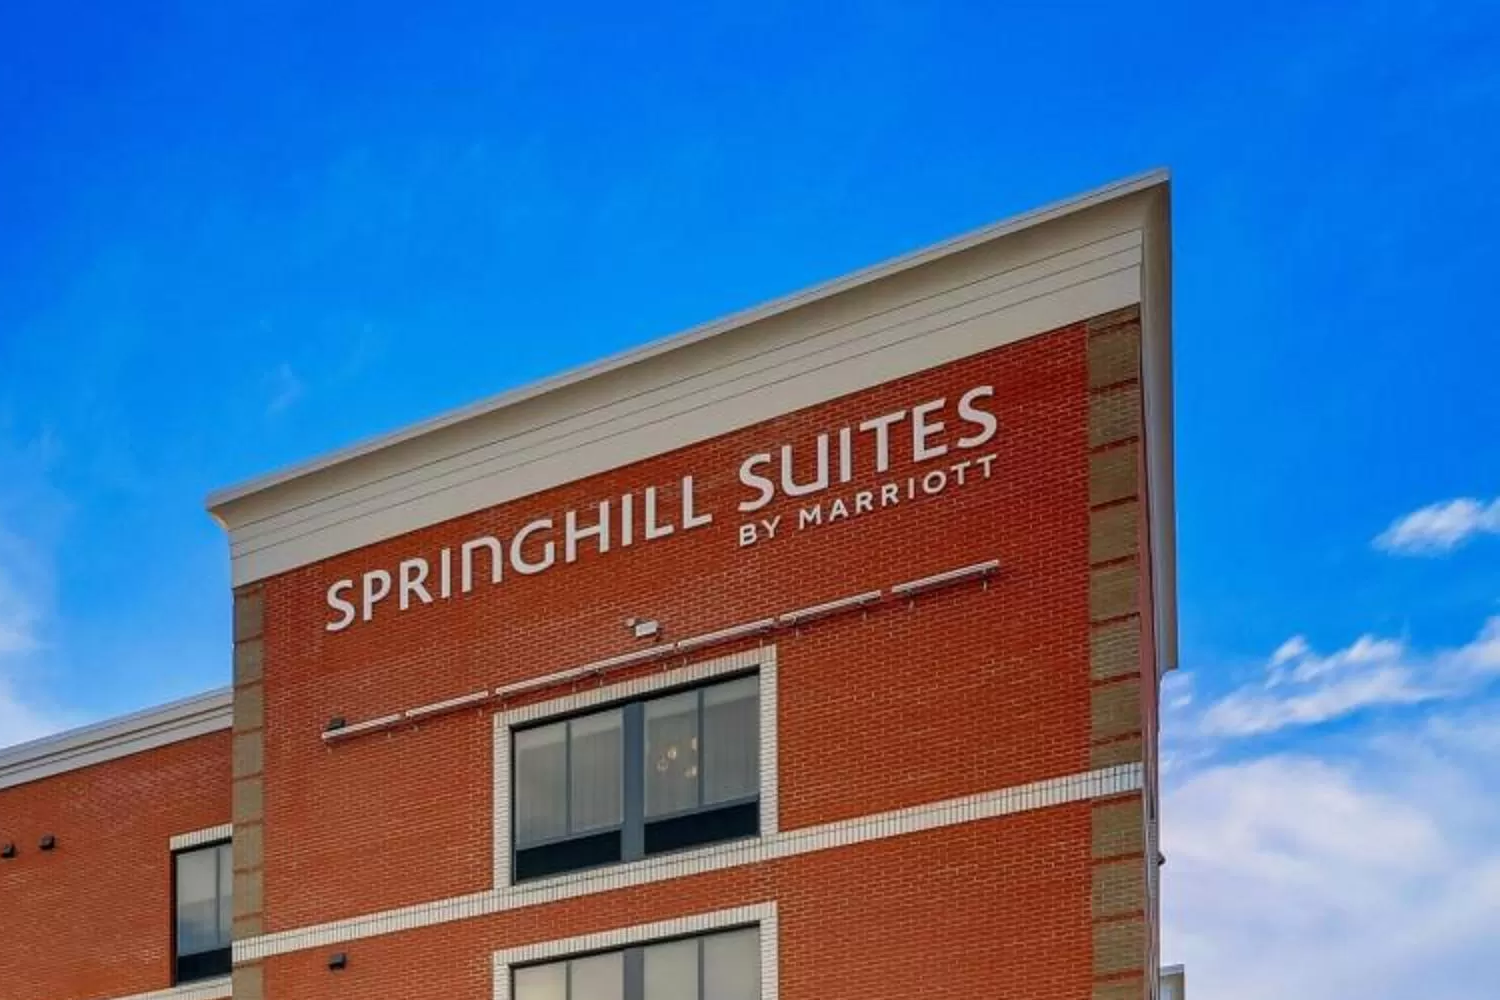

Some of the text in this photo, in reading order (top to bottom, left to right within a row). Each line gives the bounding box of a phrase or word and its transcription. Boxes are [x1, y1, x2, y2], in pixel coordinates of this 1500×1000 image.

[325, 384, 998, 632] SPRINGHILL SUITES
[738, 453, 998, 547] BY MARRIOTT
